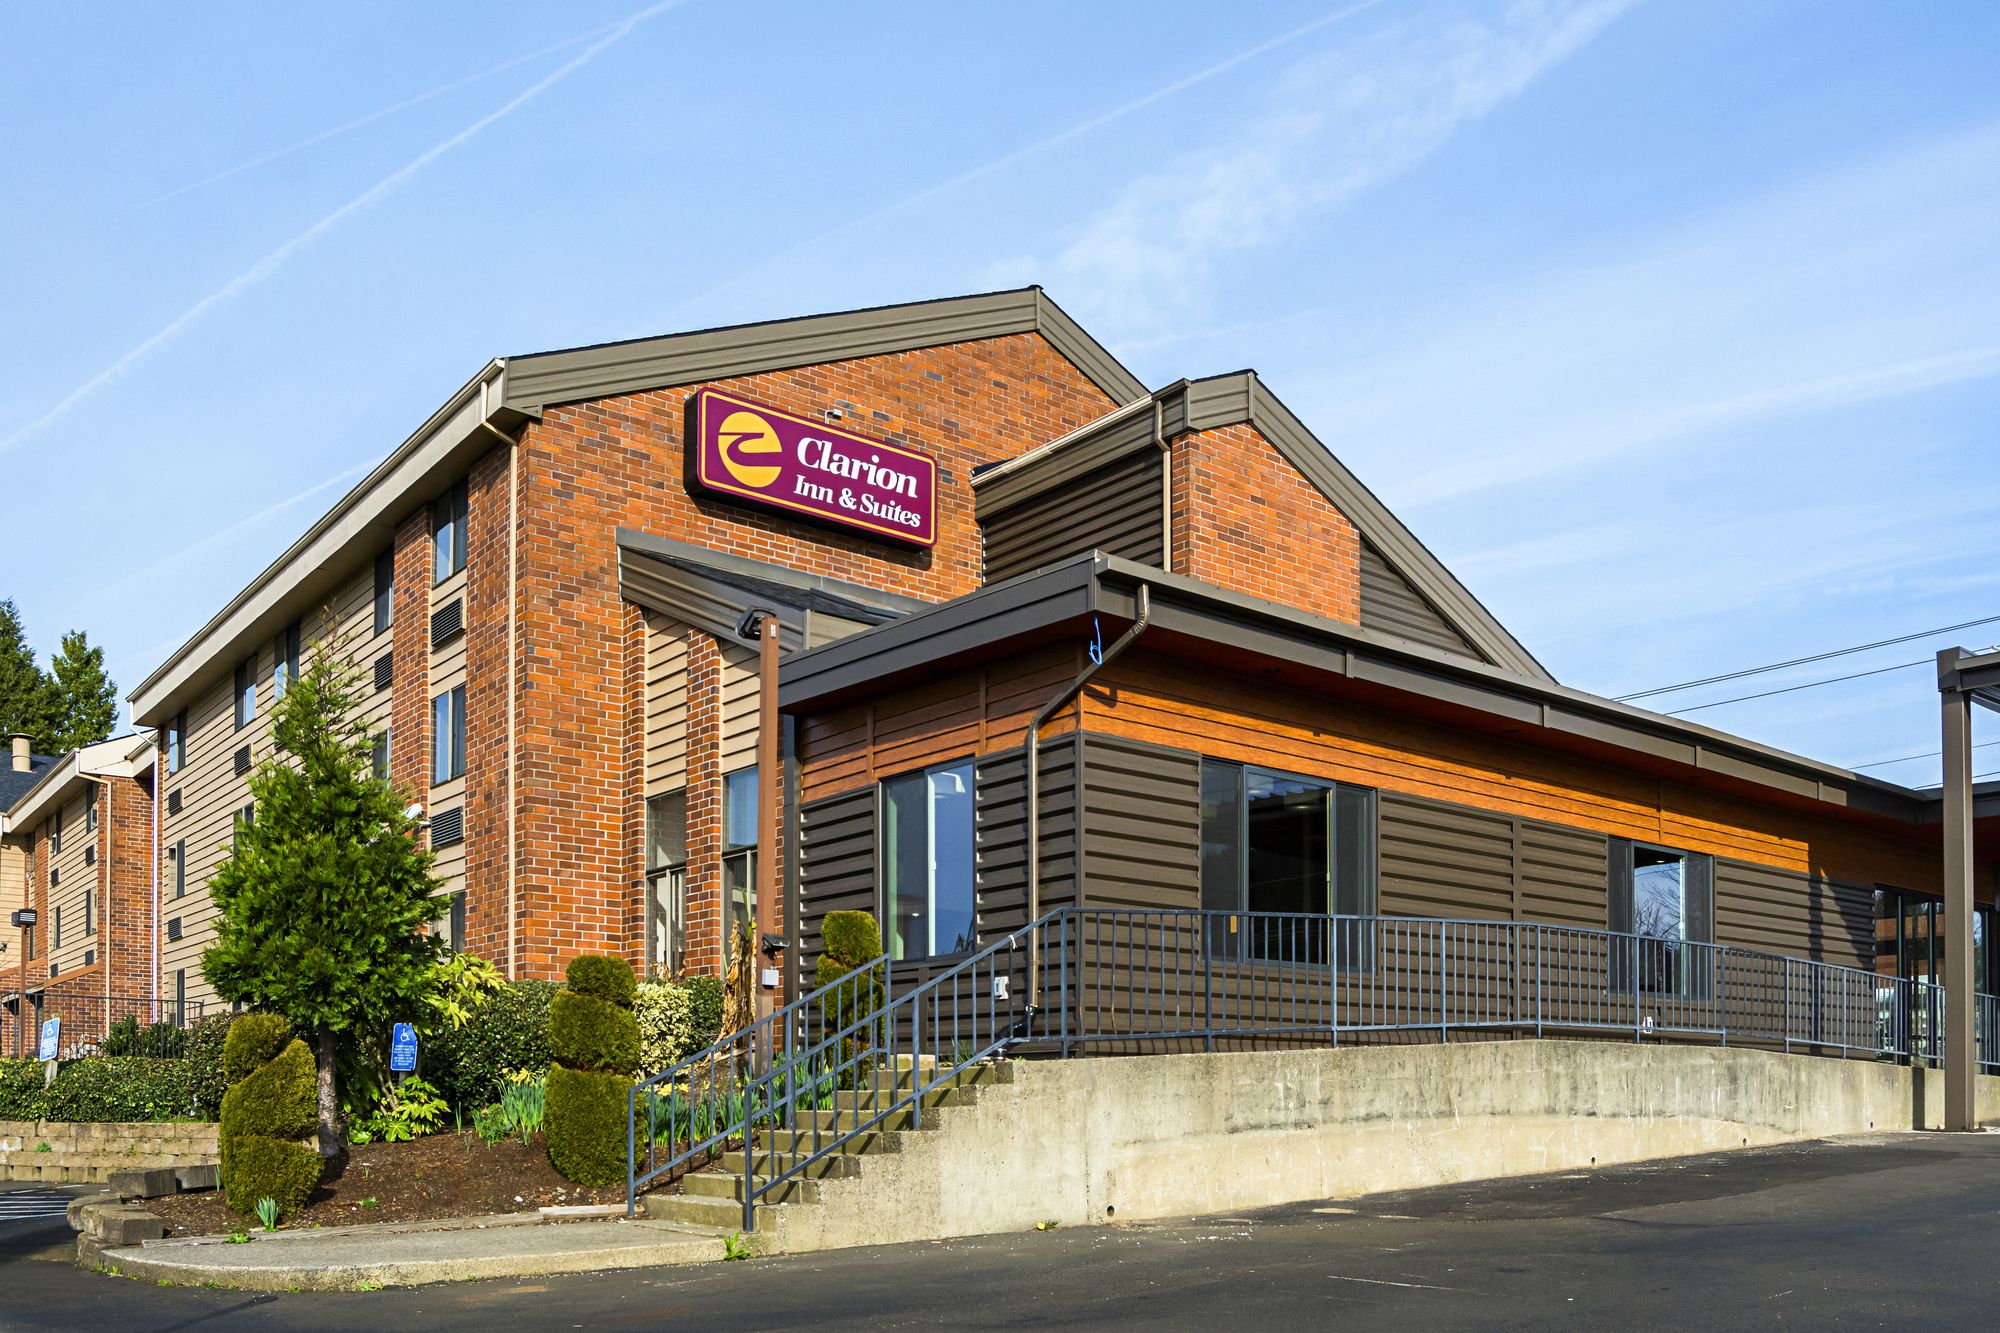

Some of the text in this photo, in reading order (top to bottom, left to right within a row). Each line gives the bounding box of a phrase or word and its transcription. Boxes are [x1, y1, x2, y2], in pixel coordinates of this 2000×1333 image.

[797, 437, 918, 498] Clarion
[793, 474, 921, 528] Inn & Suites
